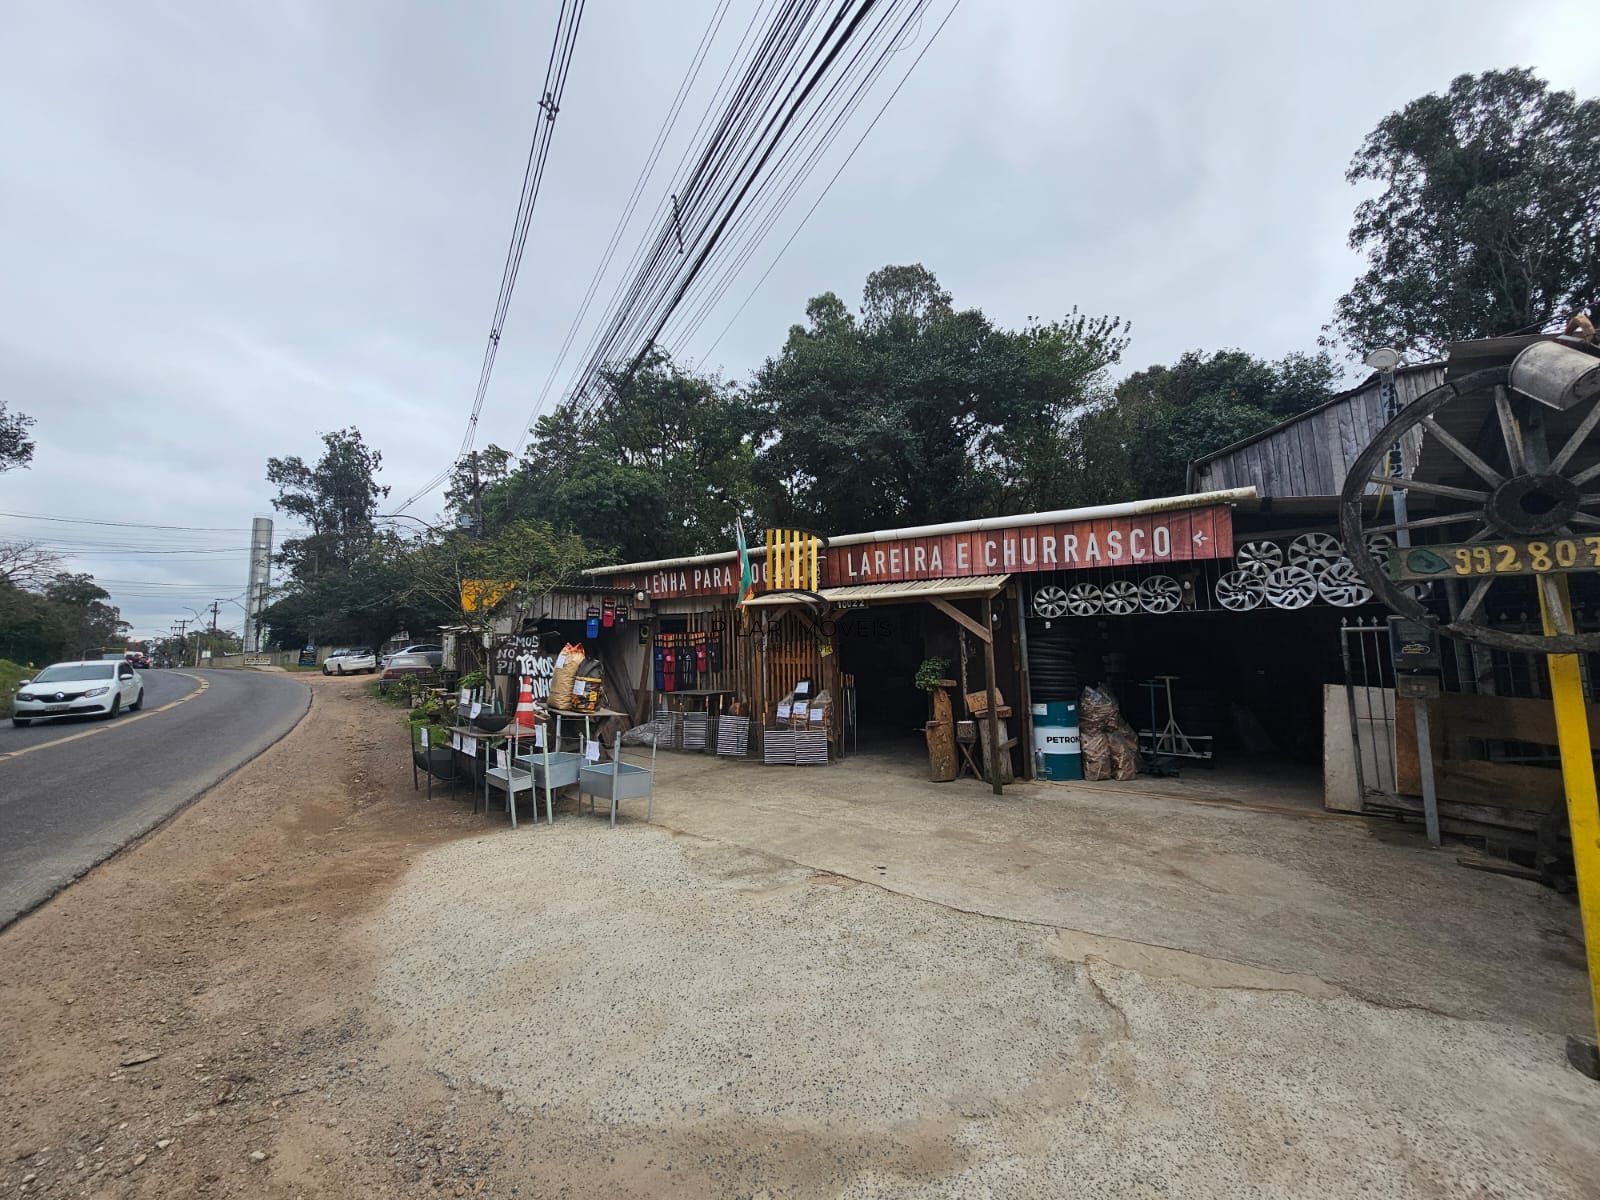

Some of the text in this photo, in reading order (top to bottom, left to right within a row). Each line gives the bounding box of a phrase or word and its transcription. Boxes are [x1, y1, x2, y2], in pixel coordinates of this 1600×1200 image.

[645, 571, 687, 593] LENHA
[694, 566, 732, 589] PARA
[847, 545, 943, 577] LAREIRA
[956, 543, 969, 569] E
[984, 526, 1171, 567] CHURRASCO
